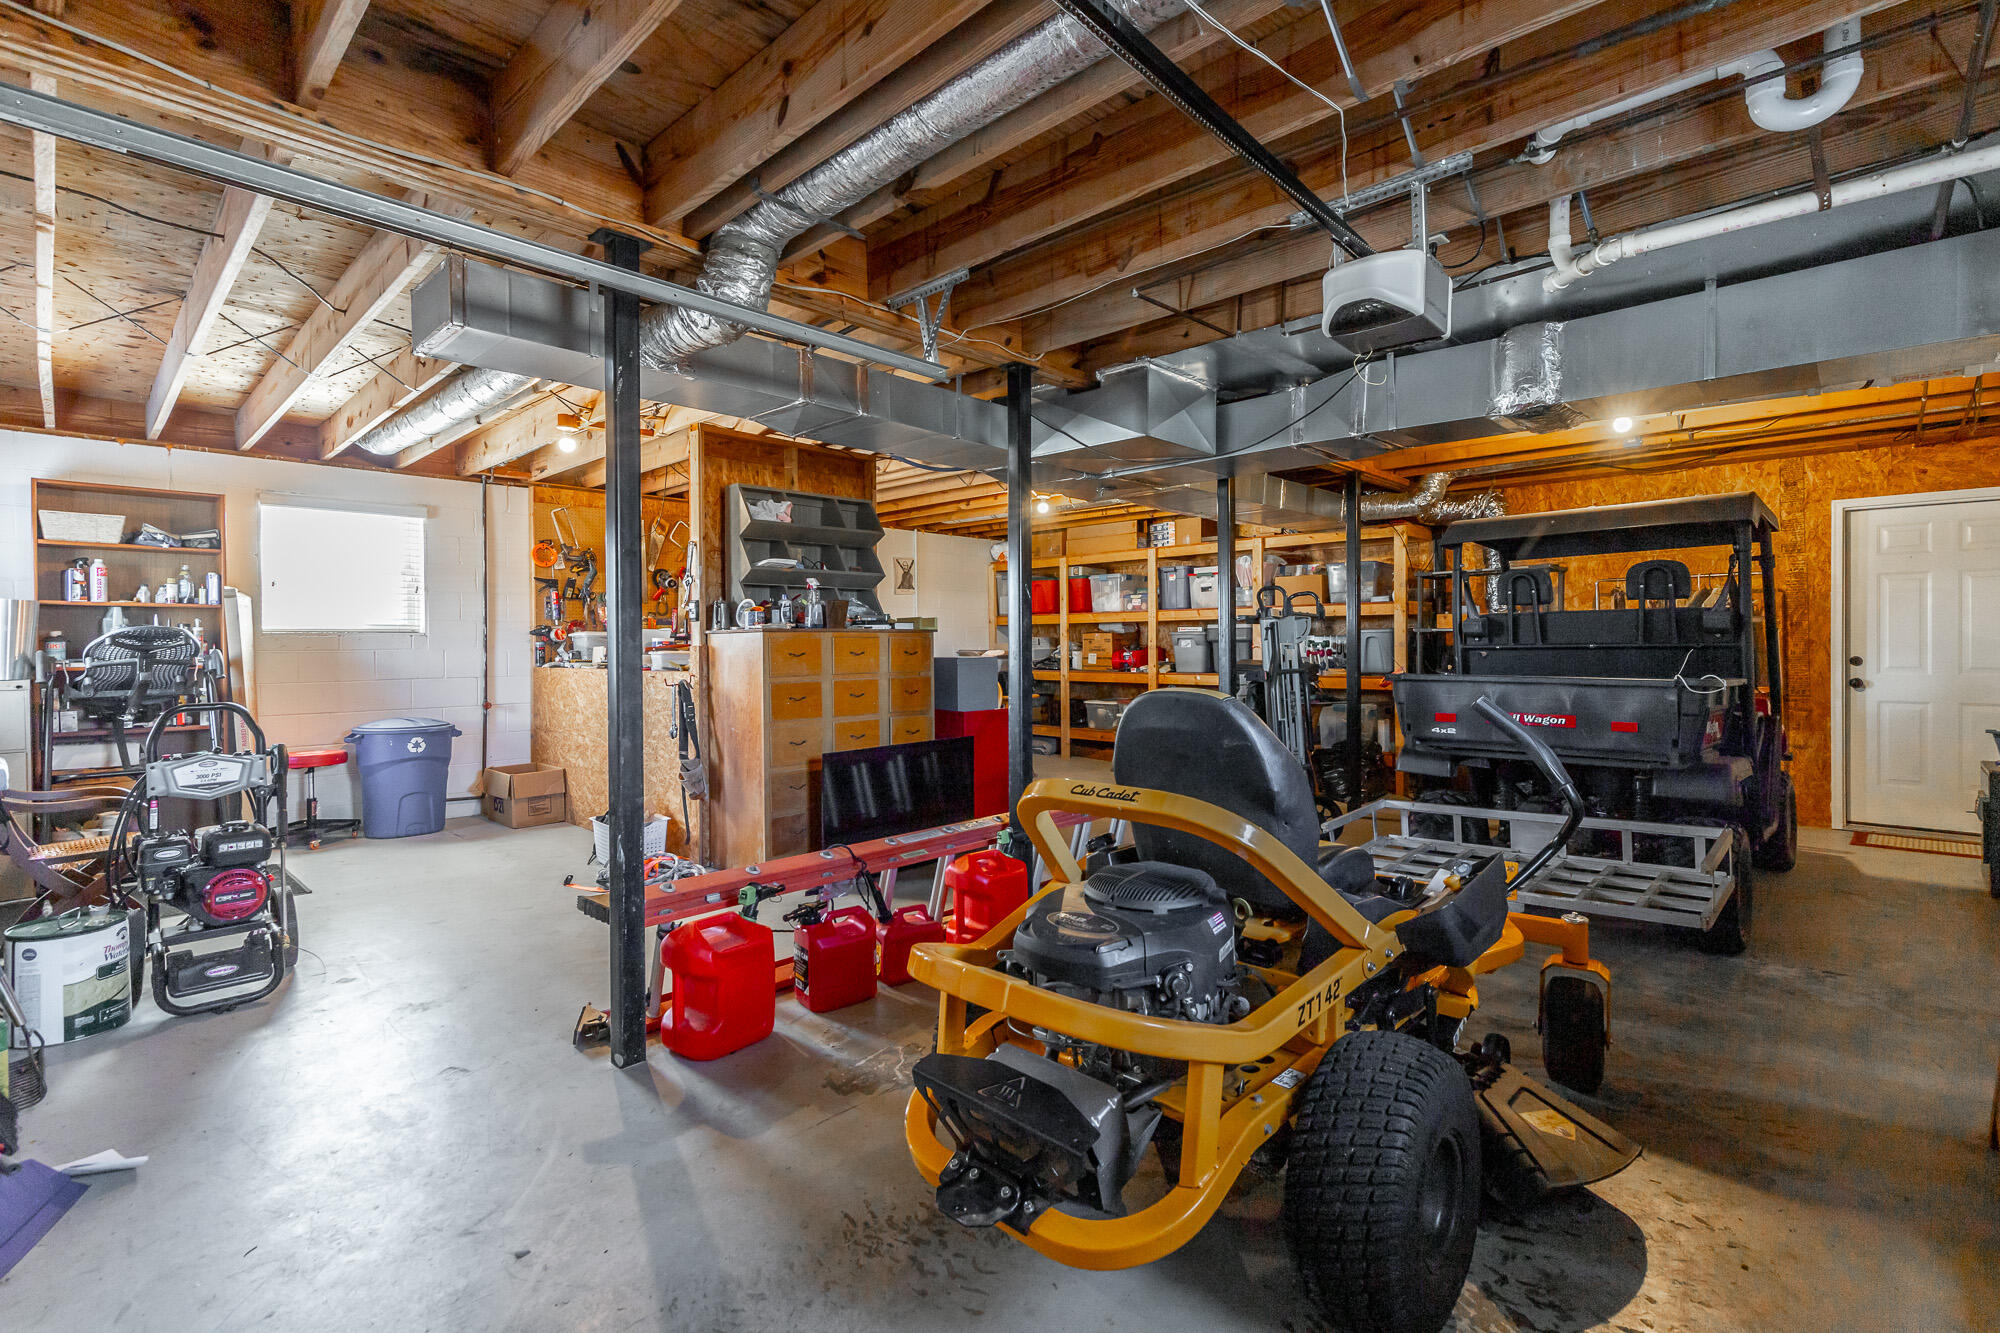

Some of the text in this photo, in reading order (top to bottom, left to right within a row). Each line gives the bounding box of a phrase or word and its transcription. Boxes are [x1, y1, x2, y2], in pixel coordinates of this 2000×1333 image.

[1523, 714, 1566, 726] Wagon
[1431, 727, 1456, 735] 4x2
[1070, 784, 1142, 802] Cub Cadet
[1297, 978, 1340, 1028] ZT1 42
